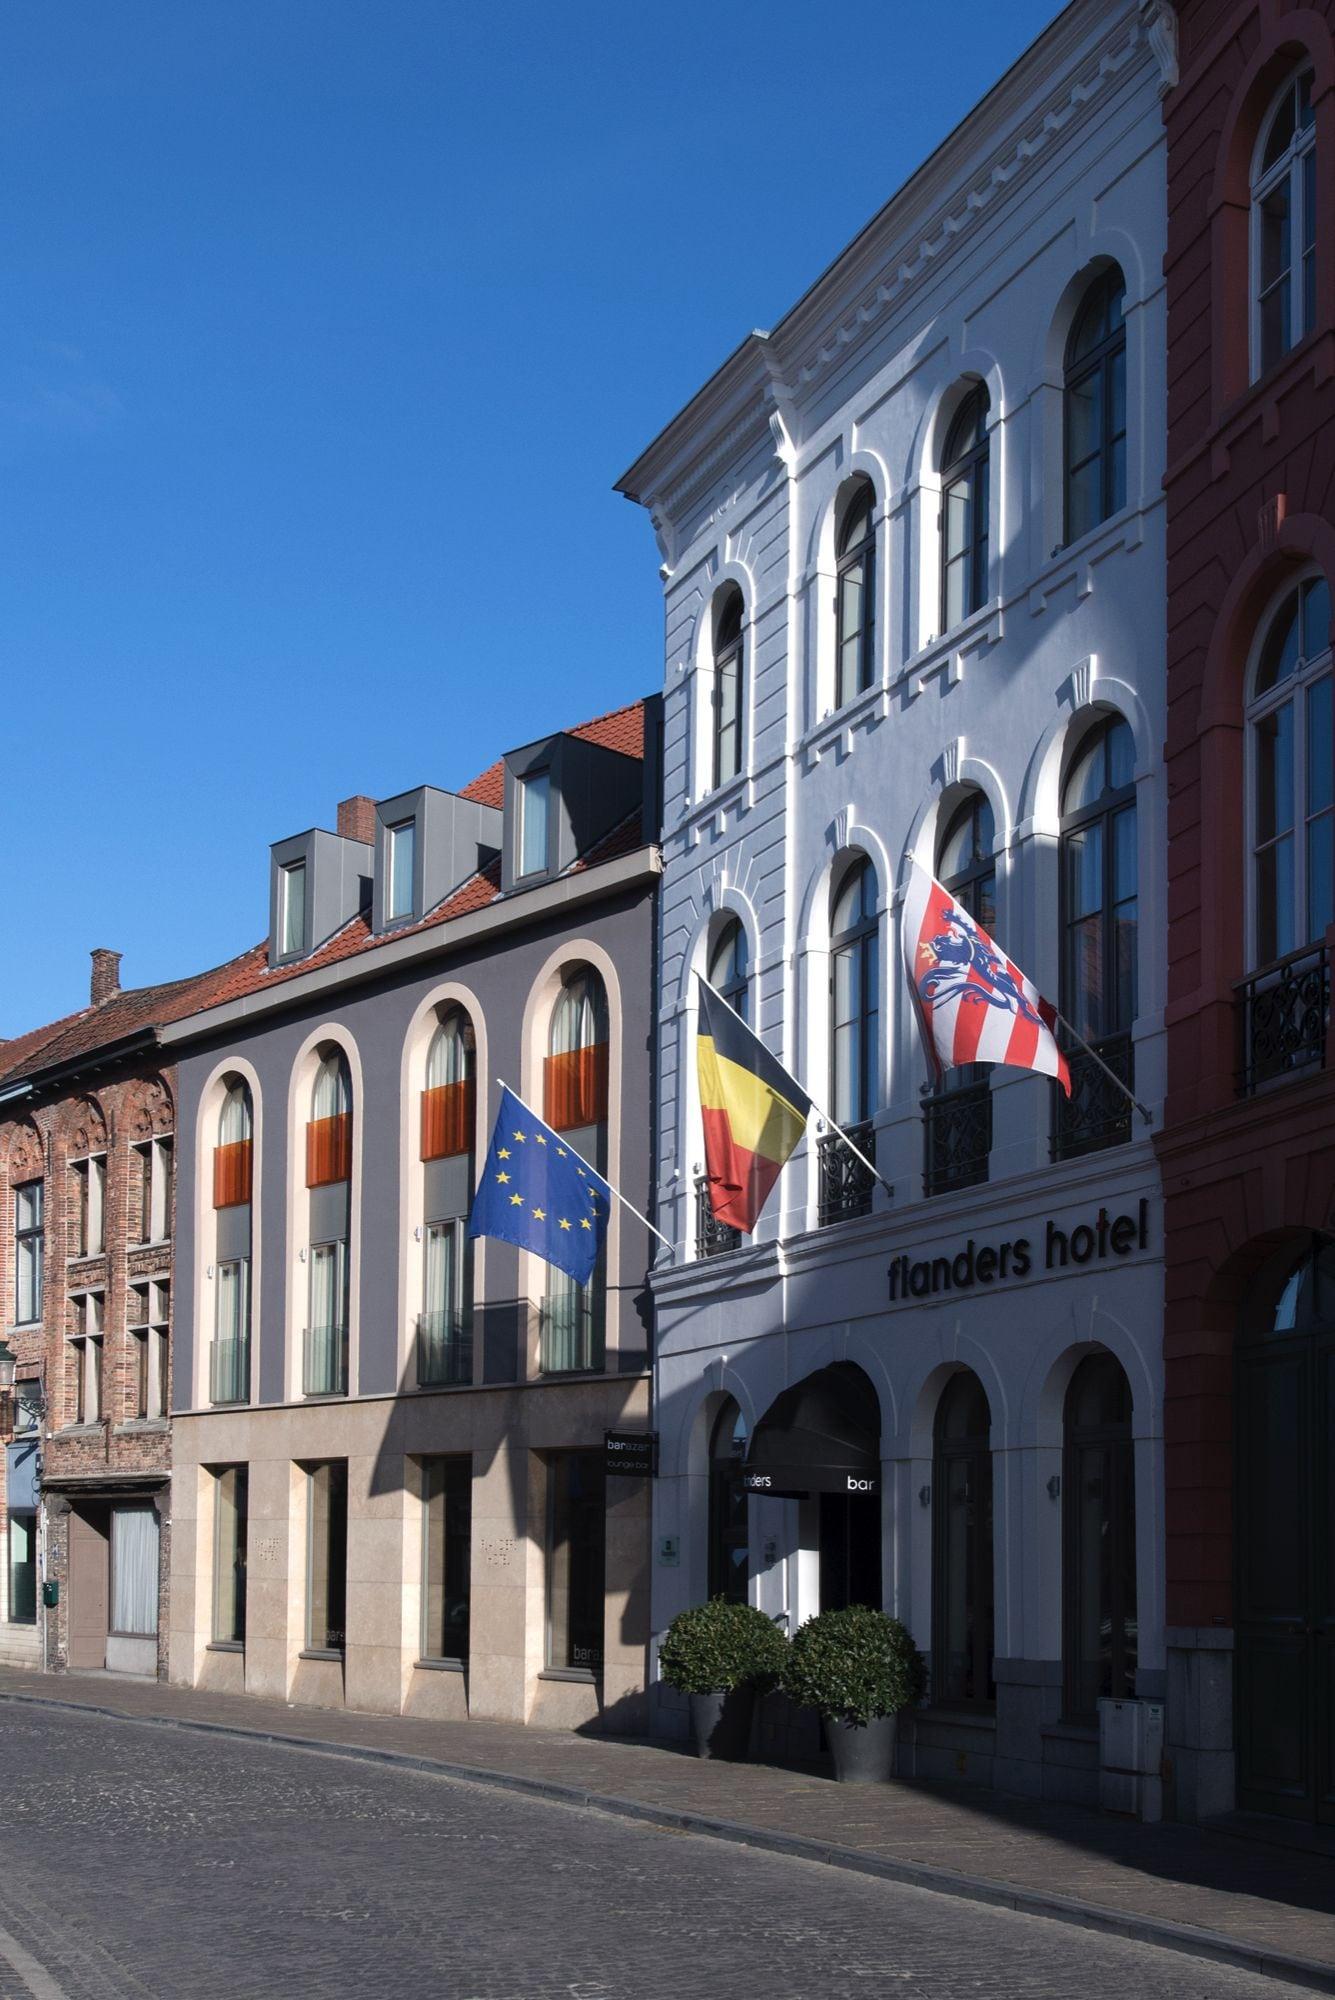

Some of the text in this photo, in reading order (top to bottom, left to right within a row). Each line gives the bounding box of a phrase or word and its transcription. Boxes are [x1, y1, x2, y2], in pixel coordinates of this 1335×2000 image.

[888, 1198, 1149, 1301] flanders hotel
[847, 1475, 876, 1491] bar
